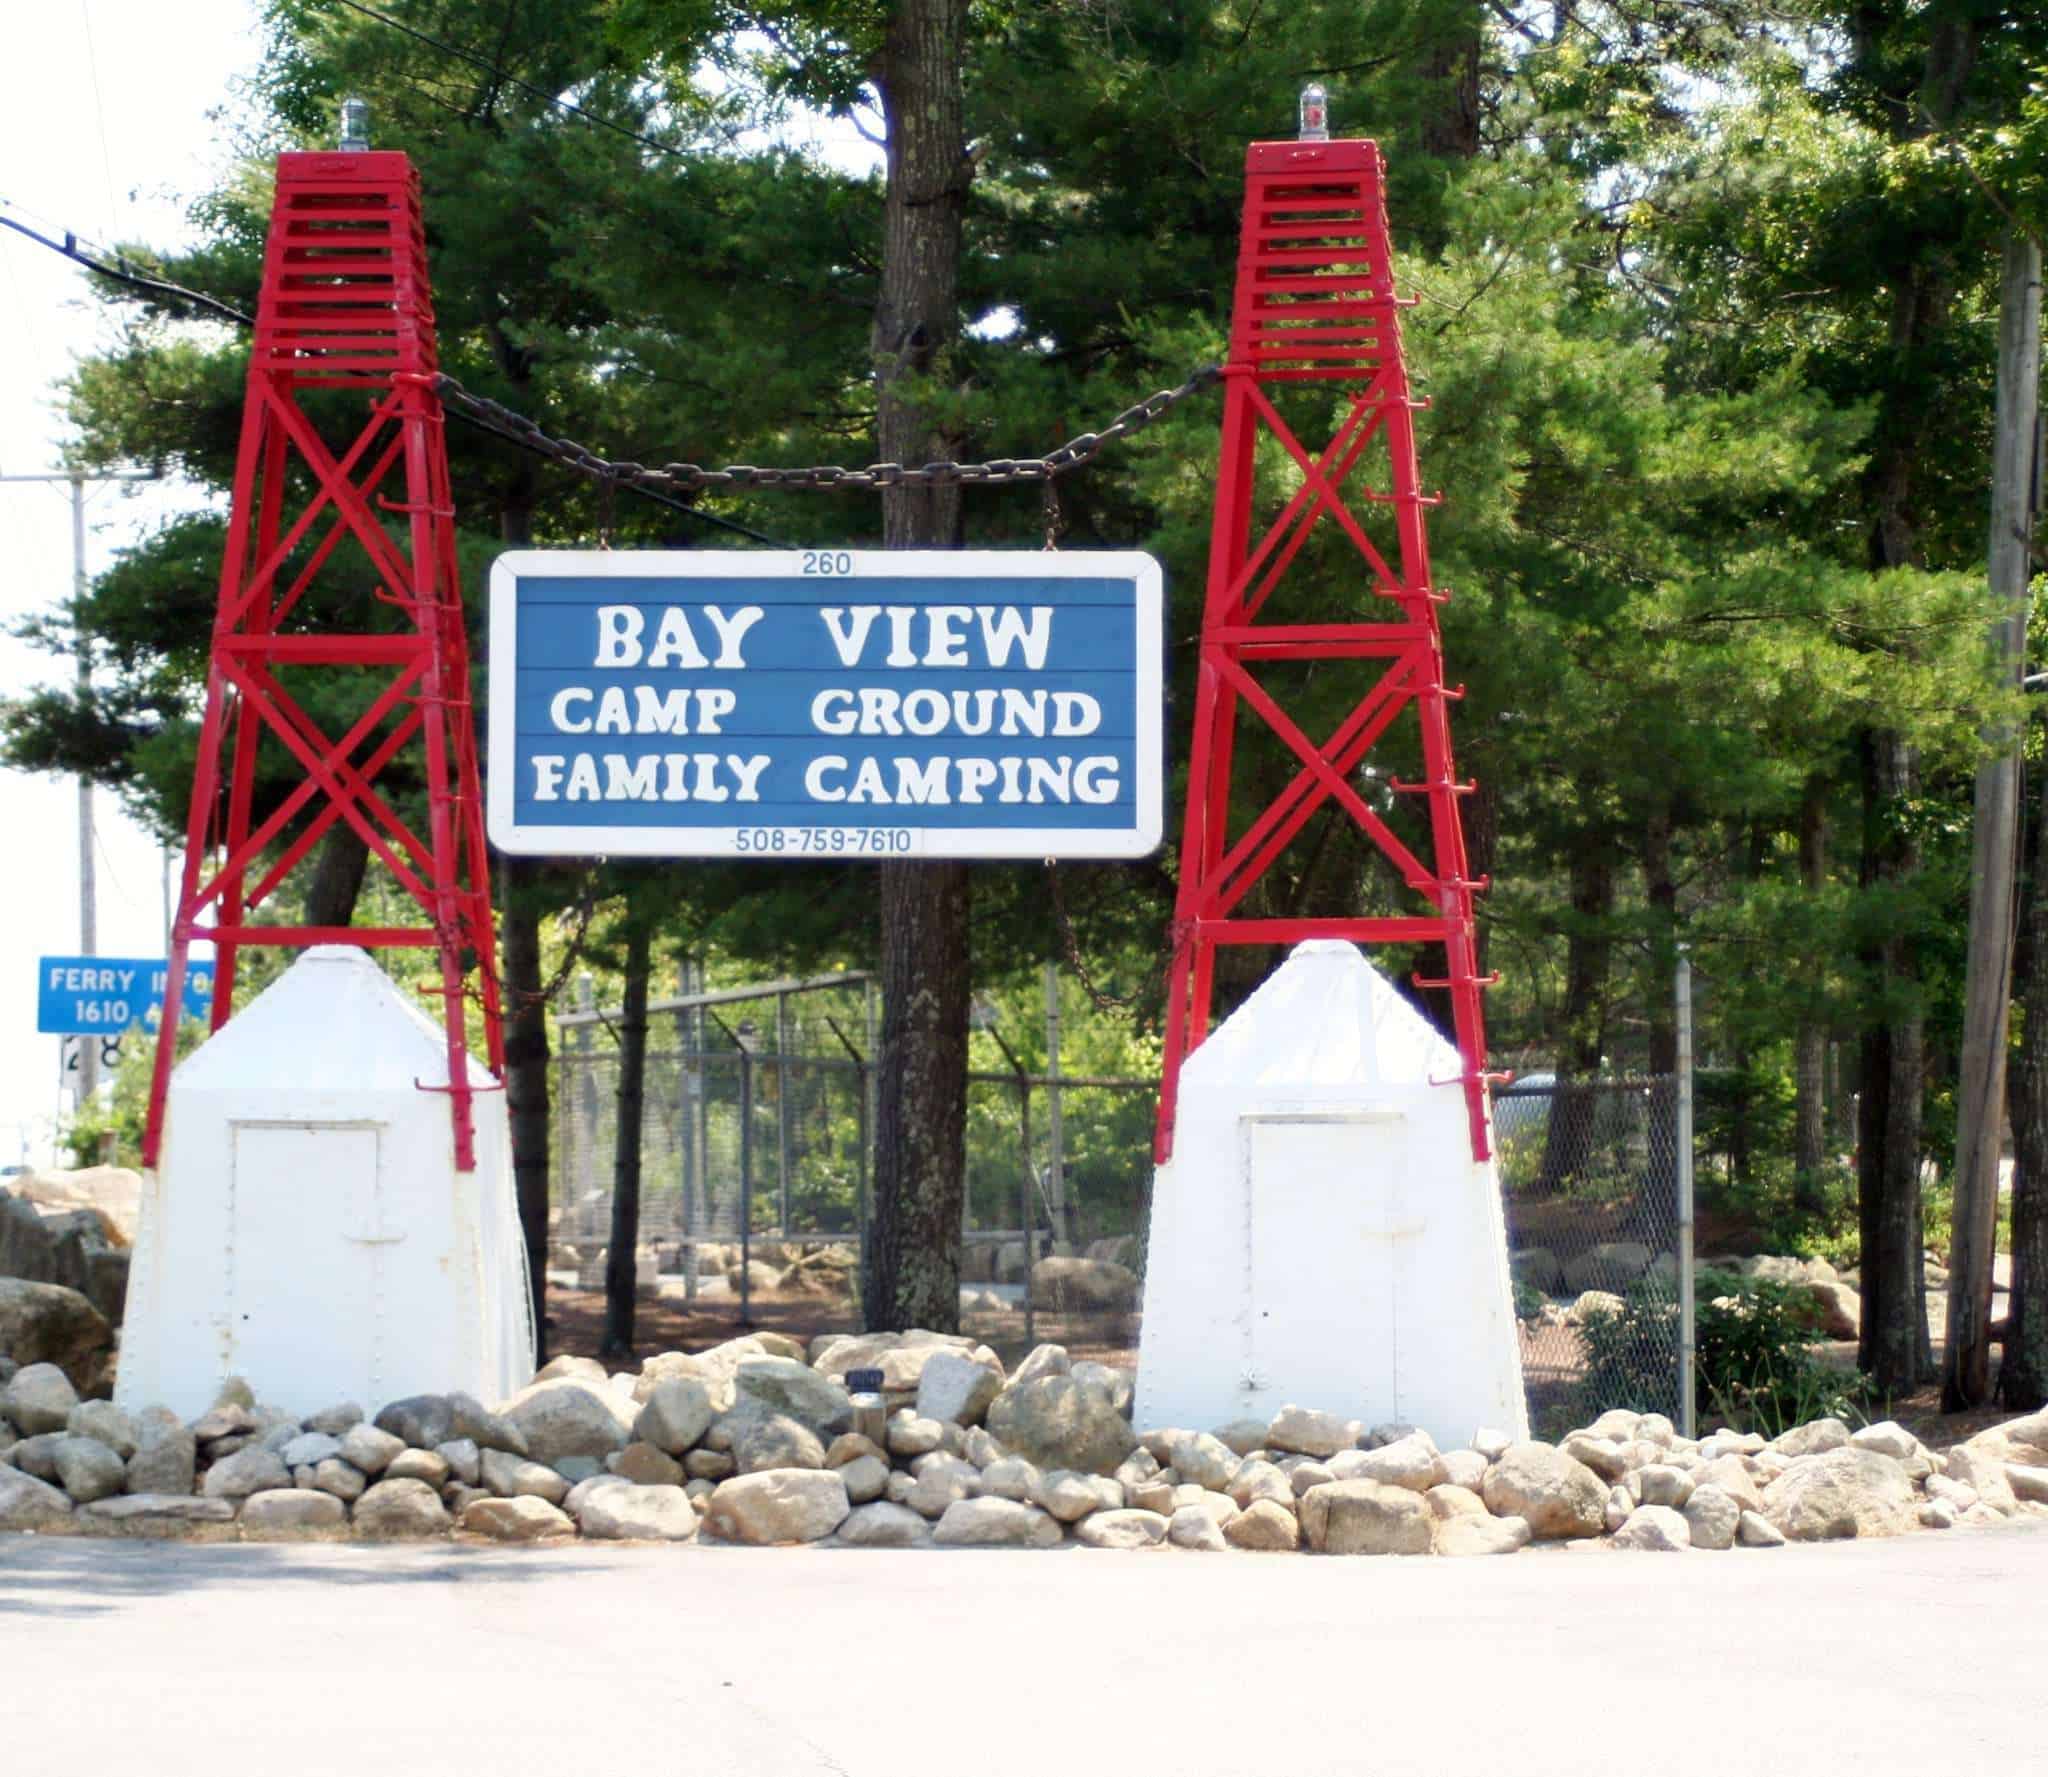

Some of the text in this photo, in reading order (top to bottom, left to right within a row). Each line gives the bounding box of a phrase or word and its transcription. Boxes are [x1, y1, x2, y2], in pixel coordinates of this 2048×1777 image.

[803, 553, 851, 573] 260
[594, 605, 1053, 669] BAY VIEW
[551, 686, 1101, 736] CAMP GROUND
[532, 753, 1119, 804] FAMILY CAMPING
[736, 829, 910, 851] 508-759-7610
[50, 968, 135, 992] FERRY
[76, 1000, 128, 1022] 1610
